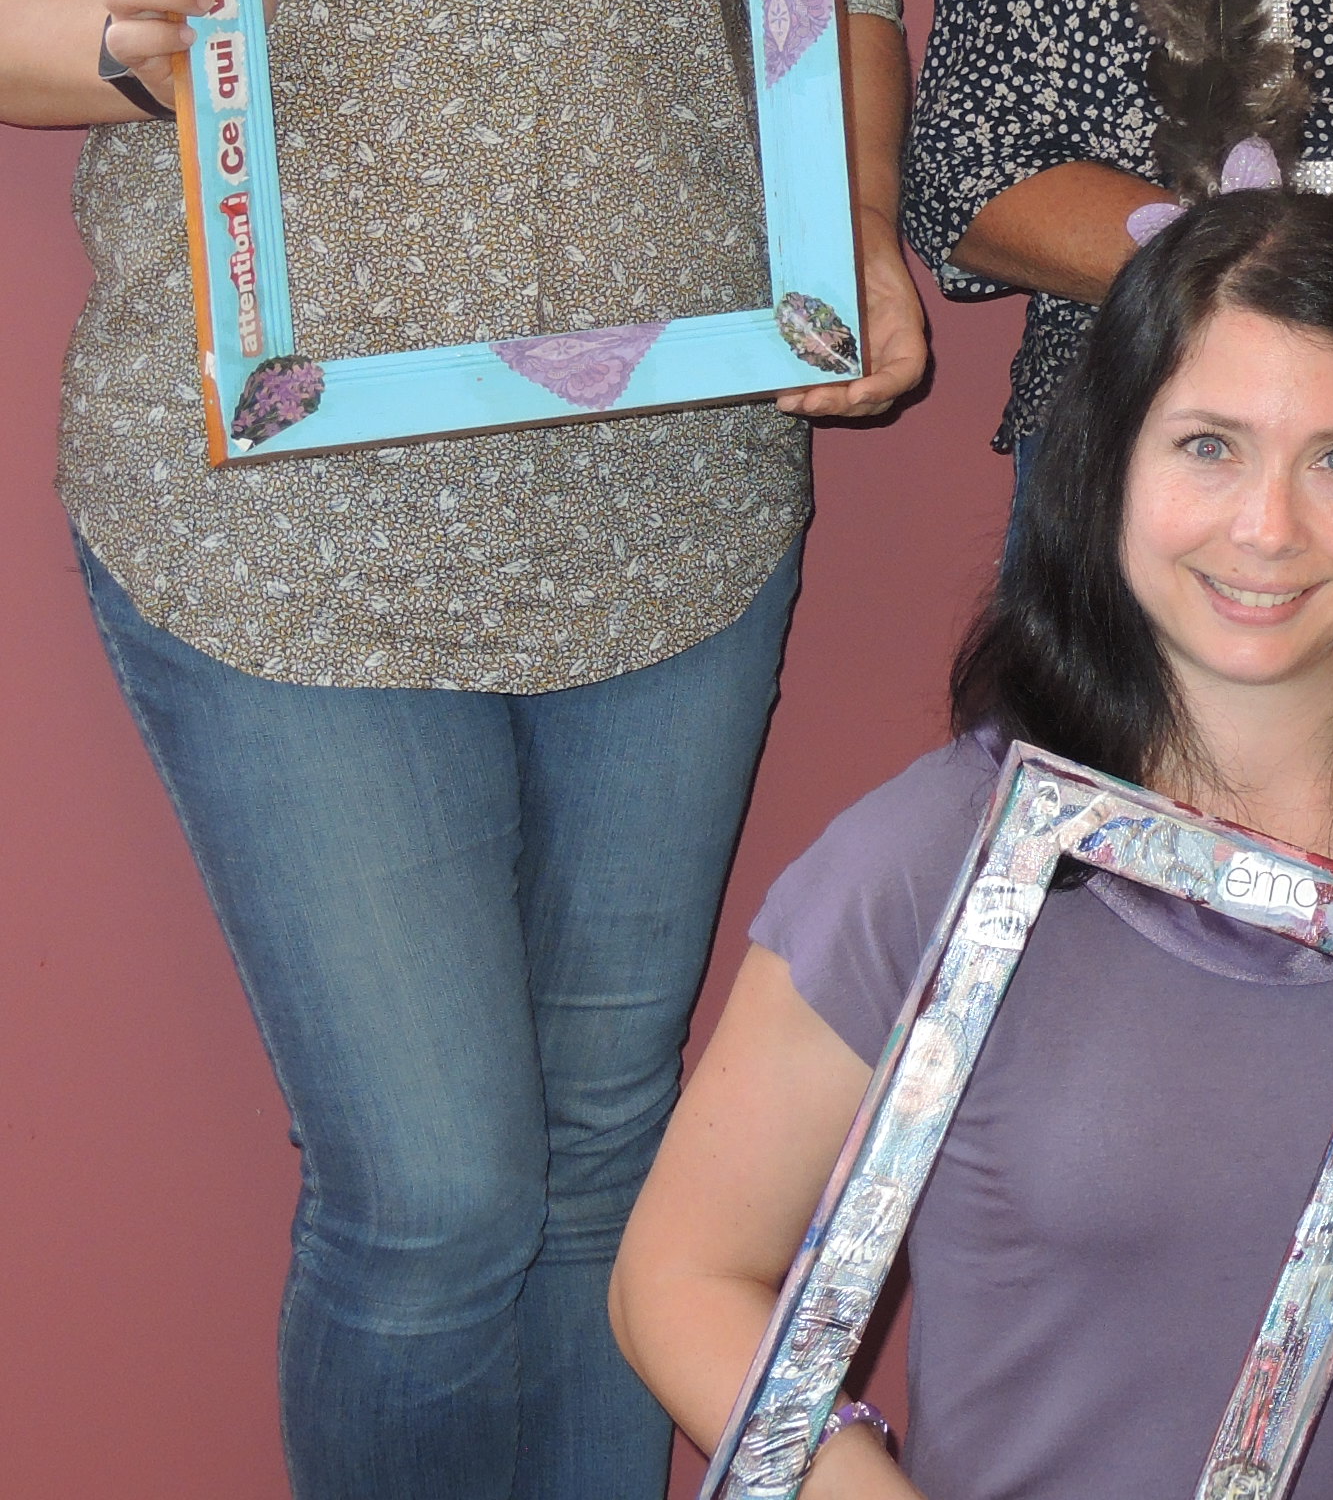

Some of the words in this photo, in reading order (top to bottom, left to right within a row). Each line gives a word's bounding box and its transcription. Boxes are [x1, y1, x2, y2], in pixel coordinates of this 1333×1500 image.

[211, 38, 239, 100] qui
[221, 121, 244, 176] Ce
[232, 214, 258, 351] attention
